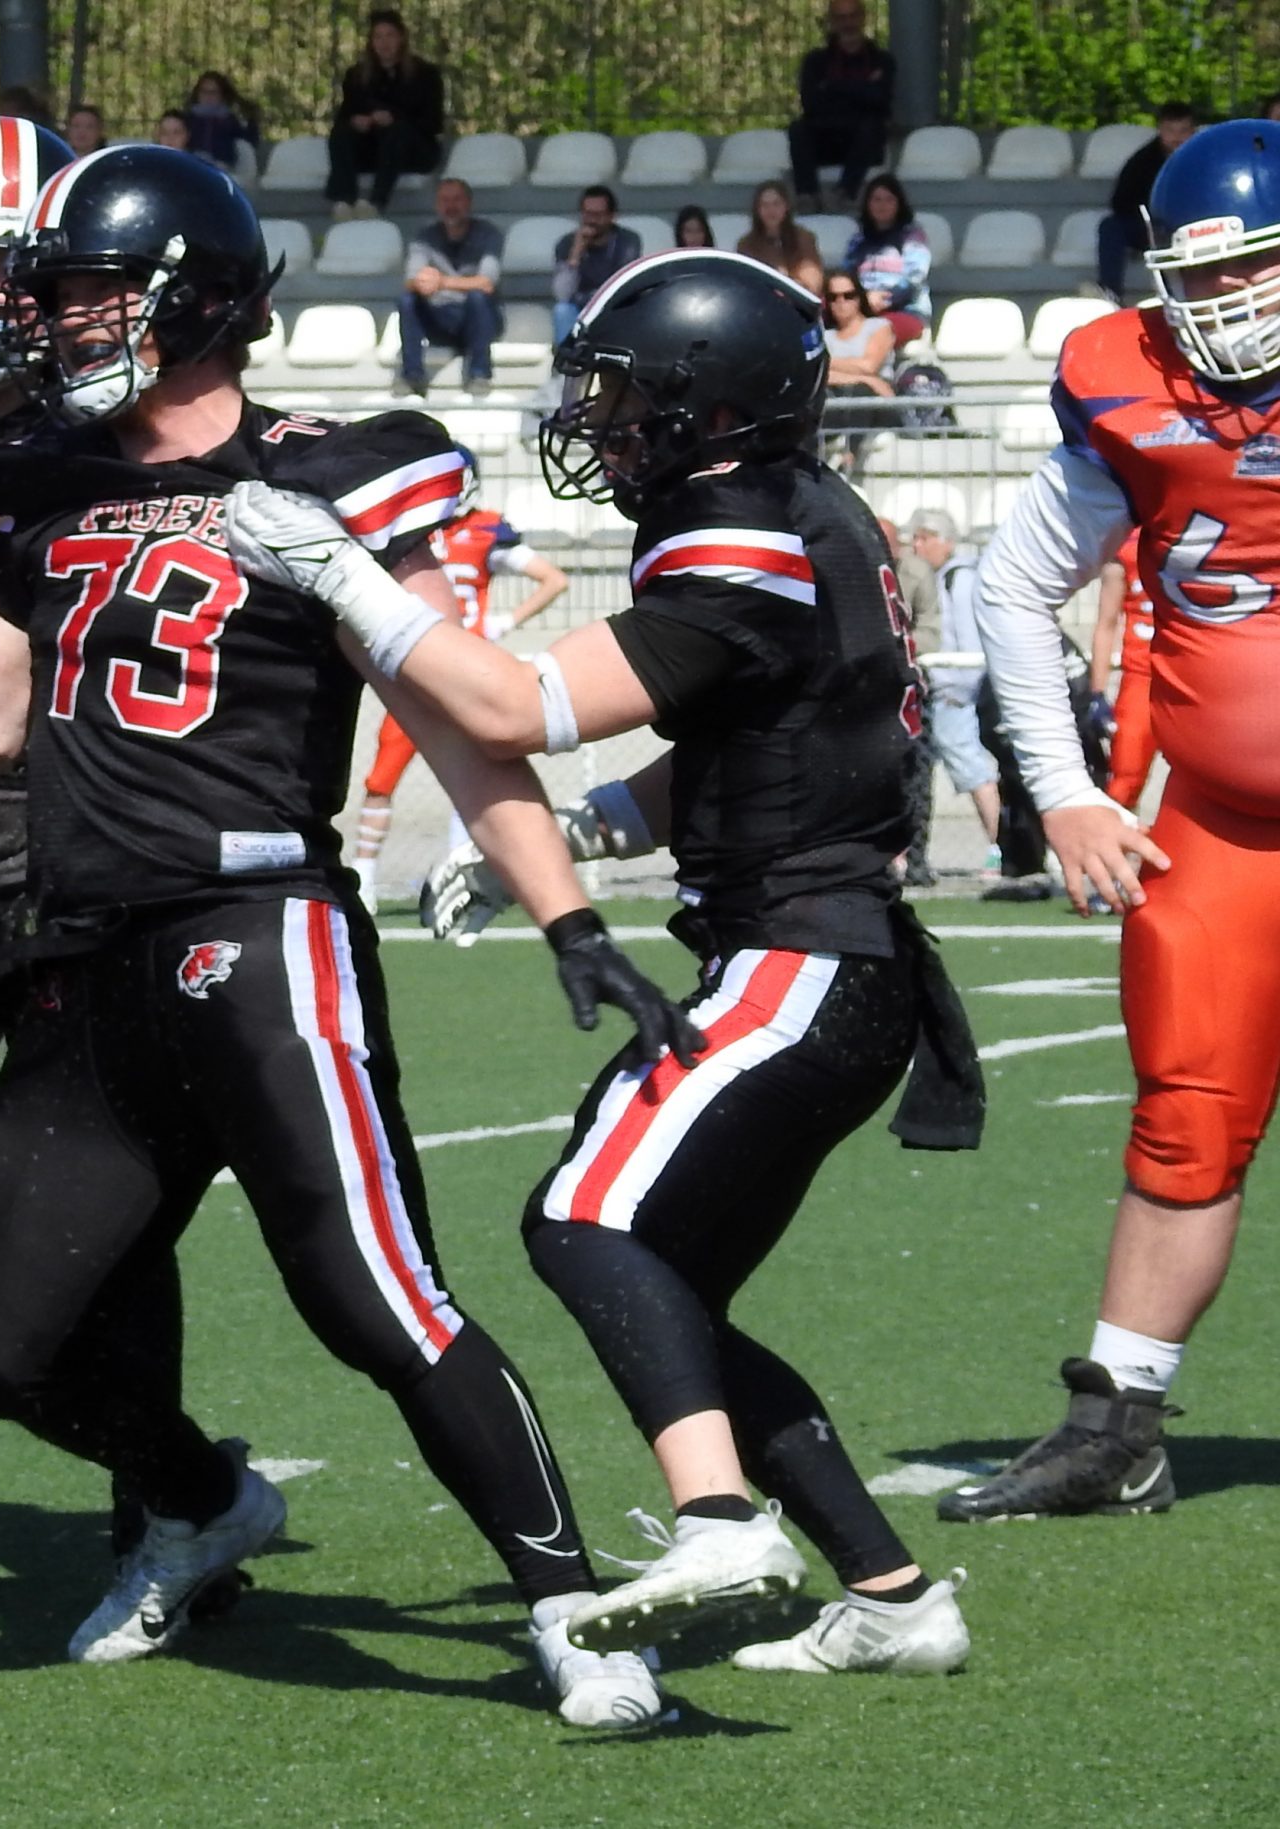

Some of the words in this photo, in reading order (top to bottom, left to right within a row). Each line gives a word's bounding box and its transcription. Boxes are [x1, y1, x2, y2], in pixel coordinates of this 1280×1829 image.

[78, 494, 229, 548] TIGER
[1157, 509, 1275, 624] 6
[45, 533, 249, 739] 73
